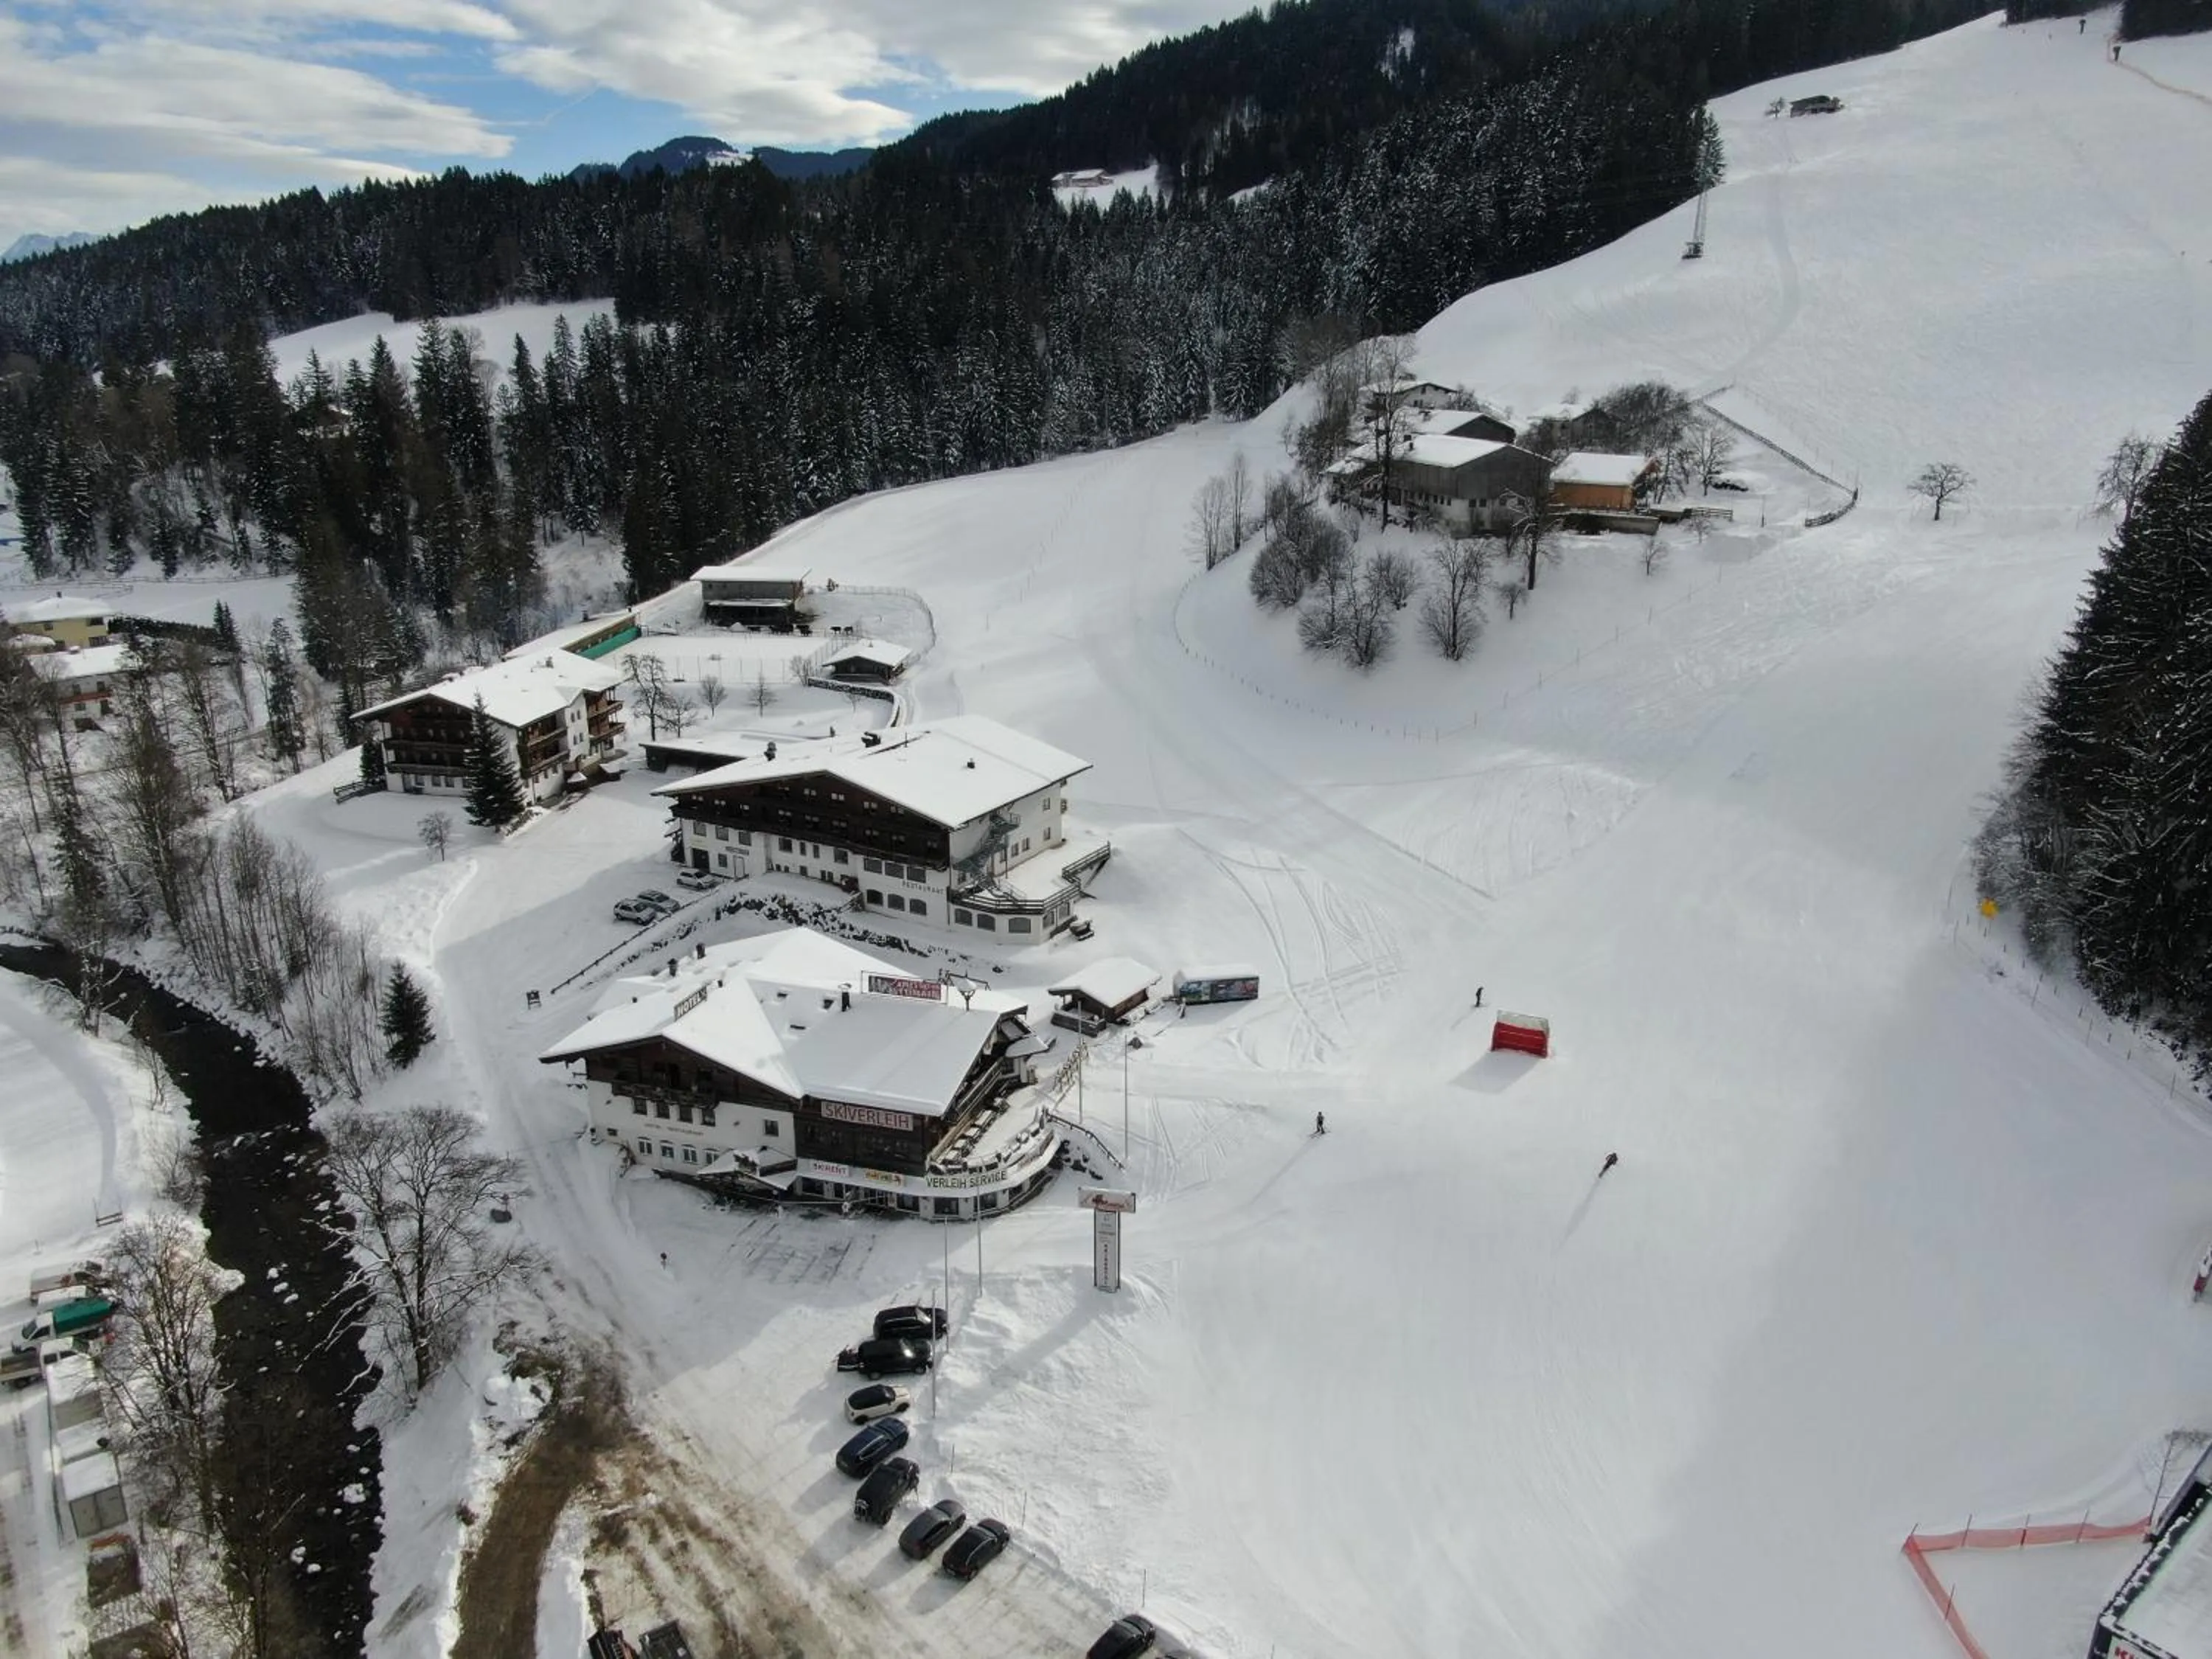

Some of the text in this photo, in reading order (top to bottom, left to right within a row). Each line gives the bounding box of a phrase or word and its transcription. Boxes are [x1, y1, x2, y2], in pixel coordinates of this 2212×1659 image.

[677, 991, 700, 1018] HOTEL
[825, 1103, 909, 1128] SKIVERLEIH
[926, 1170, 1006, 1189] VERLEIH SERVICE
